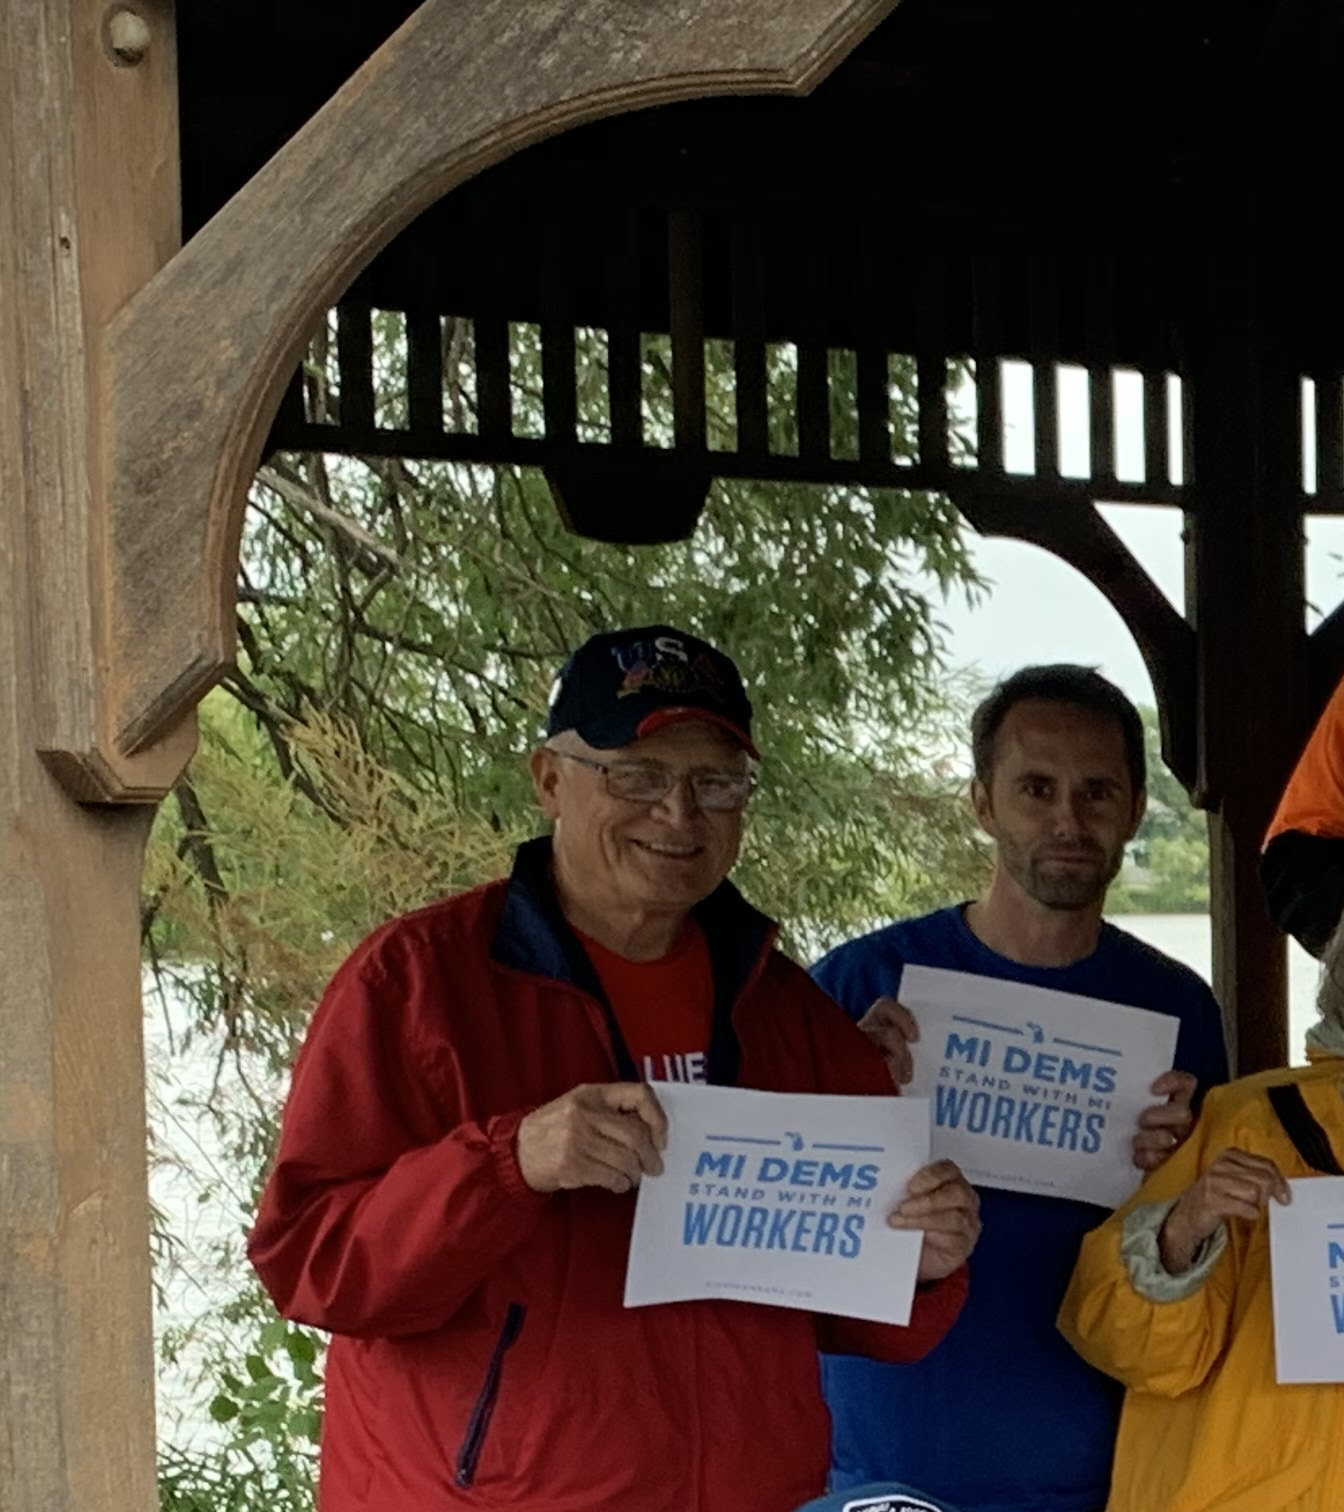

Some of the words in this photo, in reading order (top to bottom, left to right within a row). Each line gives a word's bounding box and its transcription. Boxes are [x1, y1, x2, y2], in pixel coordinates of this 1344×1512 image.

[643, 1051, 707, 1086] LUE
[945, 1033, 990, 1067] MI
[1002, 1047, 1116, 1093] DEMS
[940, 1066, 1012, 1090] STAND
[1023, 1083, 1078, 1105] WITH
[1088, 1098, 1110, 1110] MI
[936, 1086, 1106, 1153] WORKERS
[695, 1152, 745, 1180] MI
[757, 1157, 879, 1191] DEMS
[688, 1183, 765, 1201] STAND
[781, 1193, 835, 1206] WITH
[850, 1199, 872, 1209] MI
[682, 1203, 864, 1259] WORKERS
